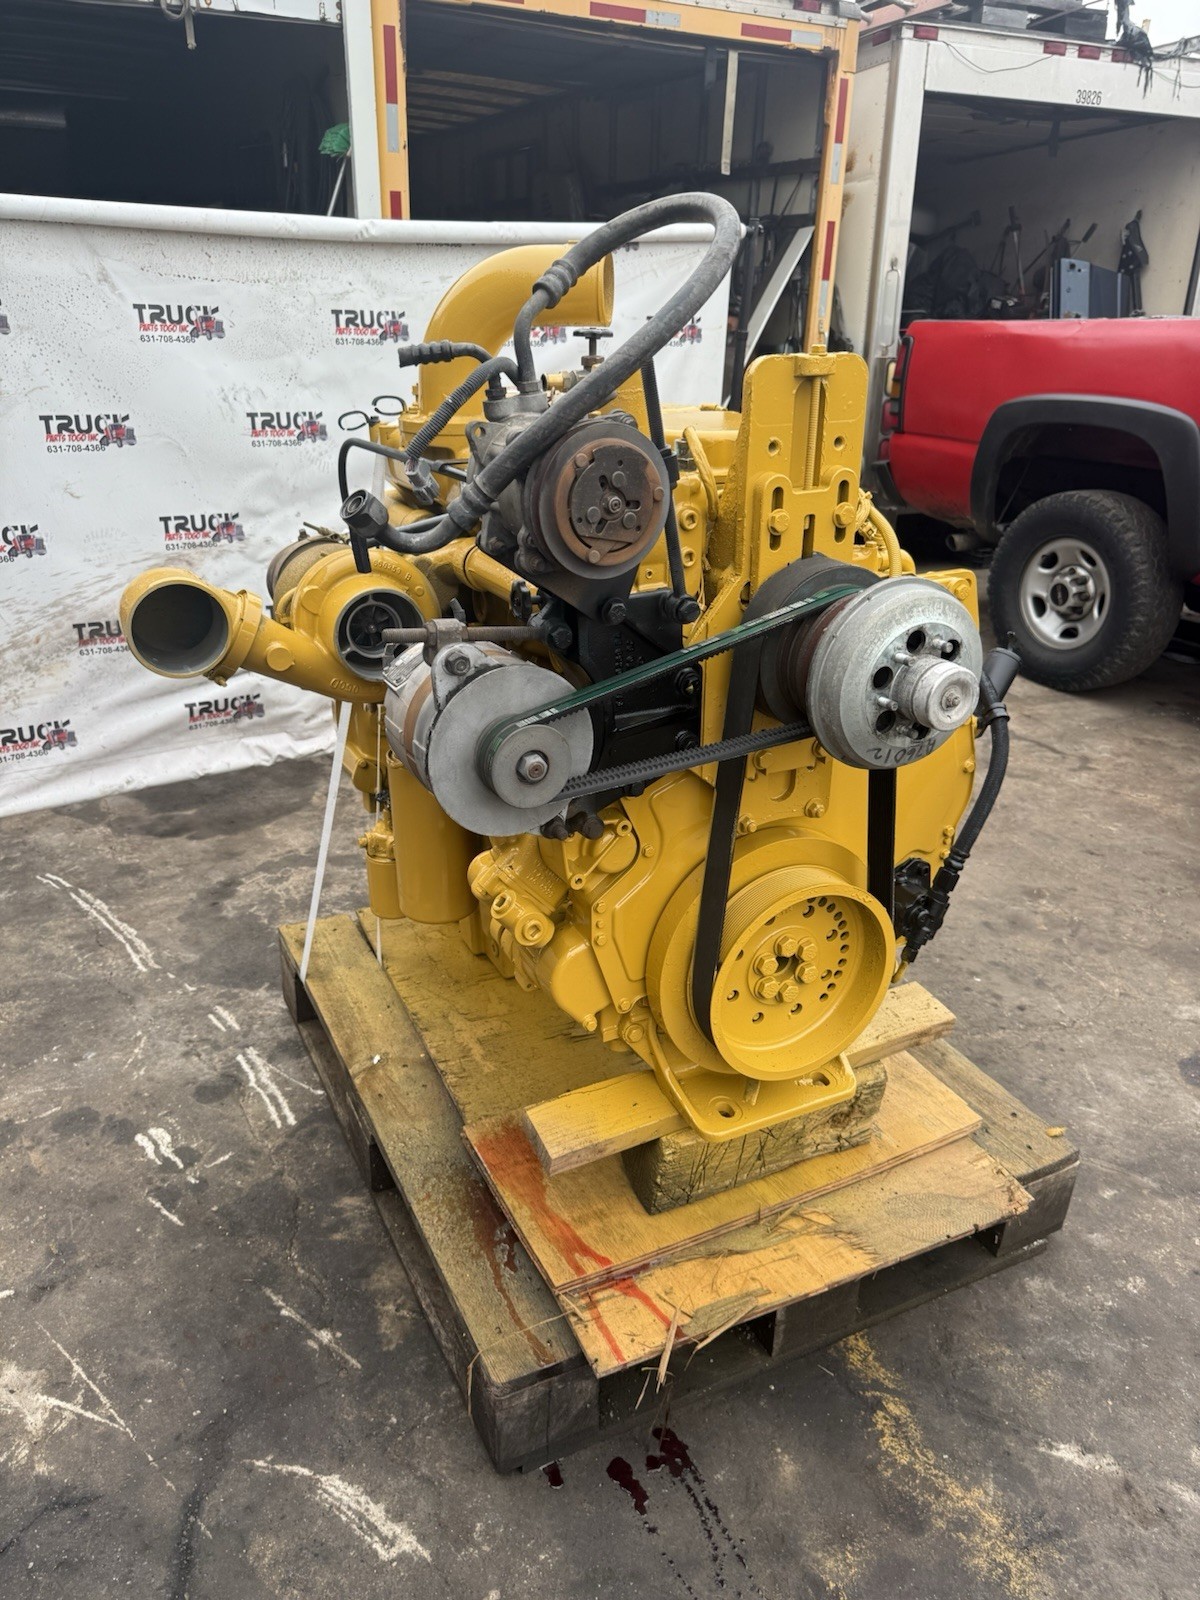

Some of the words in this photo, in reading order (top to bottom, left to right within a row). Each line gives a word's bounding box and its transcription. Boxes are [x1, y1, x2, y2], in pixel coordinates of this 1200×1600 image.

[1076, 89, 1103, 105] 39826
[139, 323, 158, 332] PARTS
[140, 334, 196, 343] 631-708-4366
[335, 337, 384, 346] 631-708-4366
[46, 433, 66, 442] PARTS
[251, 439, 302, 448] 631-708-4366
[47, 444, 106, 453] 631-708-4366
[165, 541, 218, 551] 631-708-4366
[72, 620, 122, 641] TRU
[0, 719, 71, 747] RUCK
